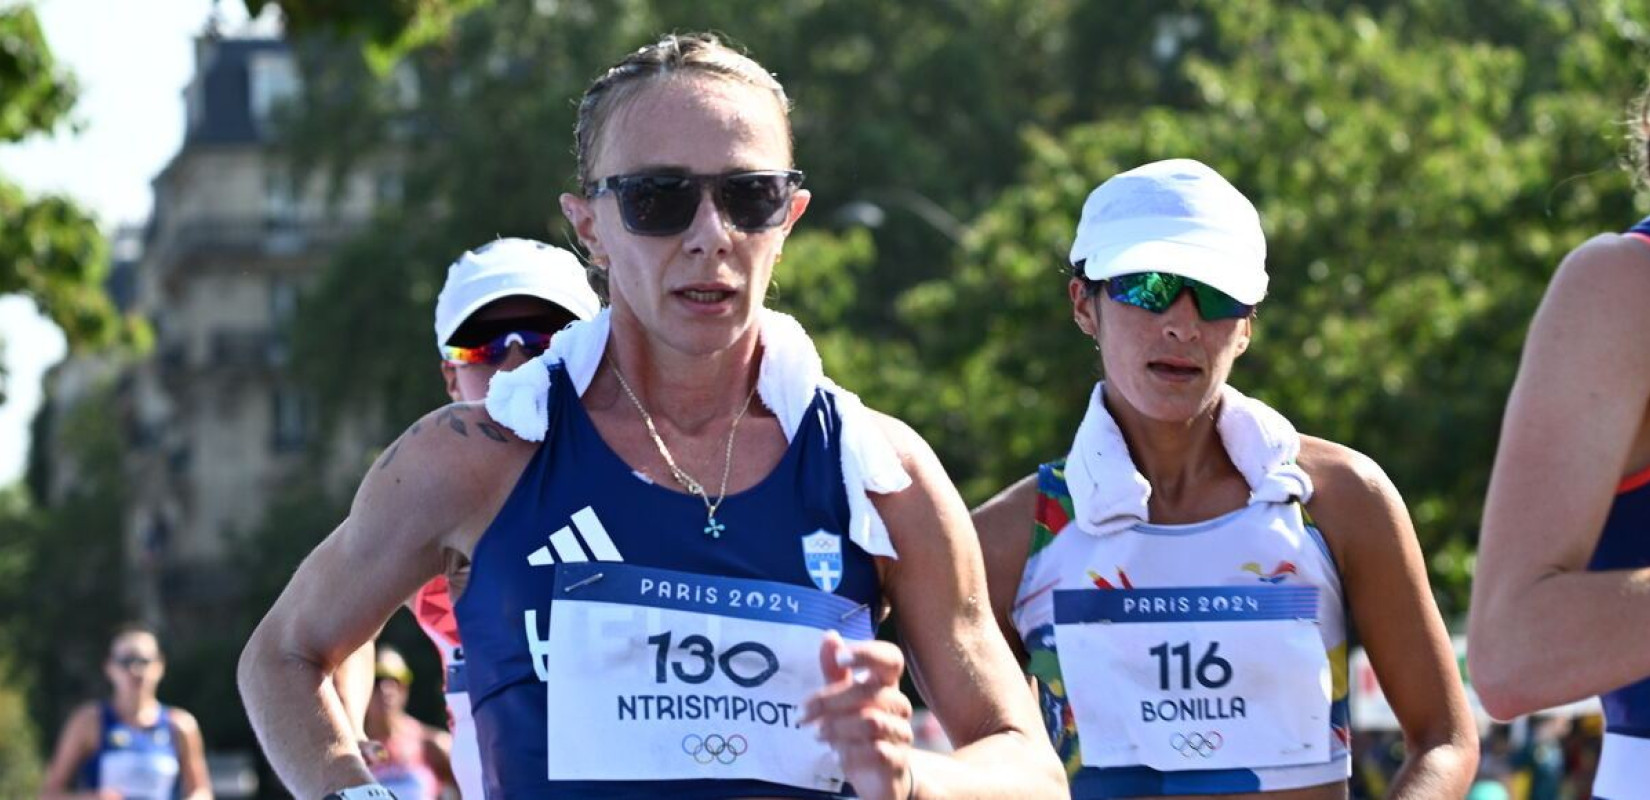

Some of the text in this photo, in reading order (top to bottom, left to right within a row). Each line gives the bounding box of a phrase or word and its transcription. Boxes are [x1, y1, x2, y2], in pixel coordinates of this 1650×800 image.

[641, 578, 799, 614] PARIS 2024
[1123, 595, 1258, 614] PARIS 2024
[648, 630, 779, 688] 130
[1149, 641, 1233, 691] 116
[617, 694, 800, 729] NTRISMPIOT
[1141, 696, 1246, 722] BONILLA
